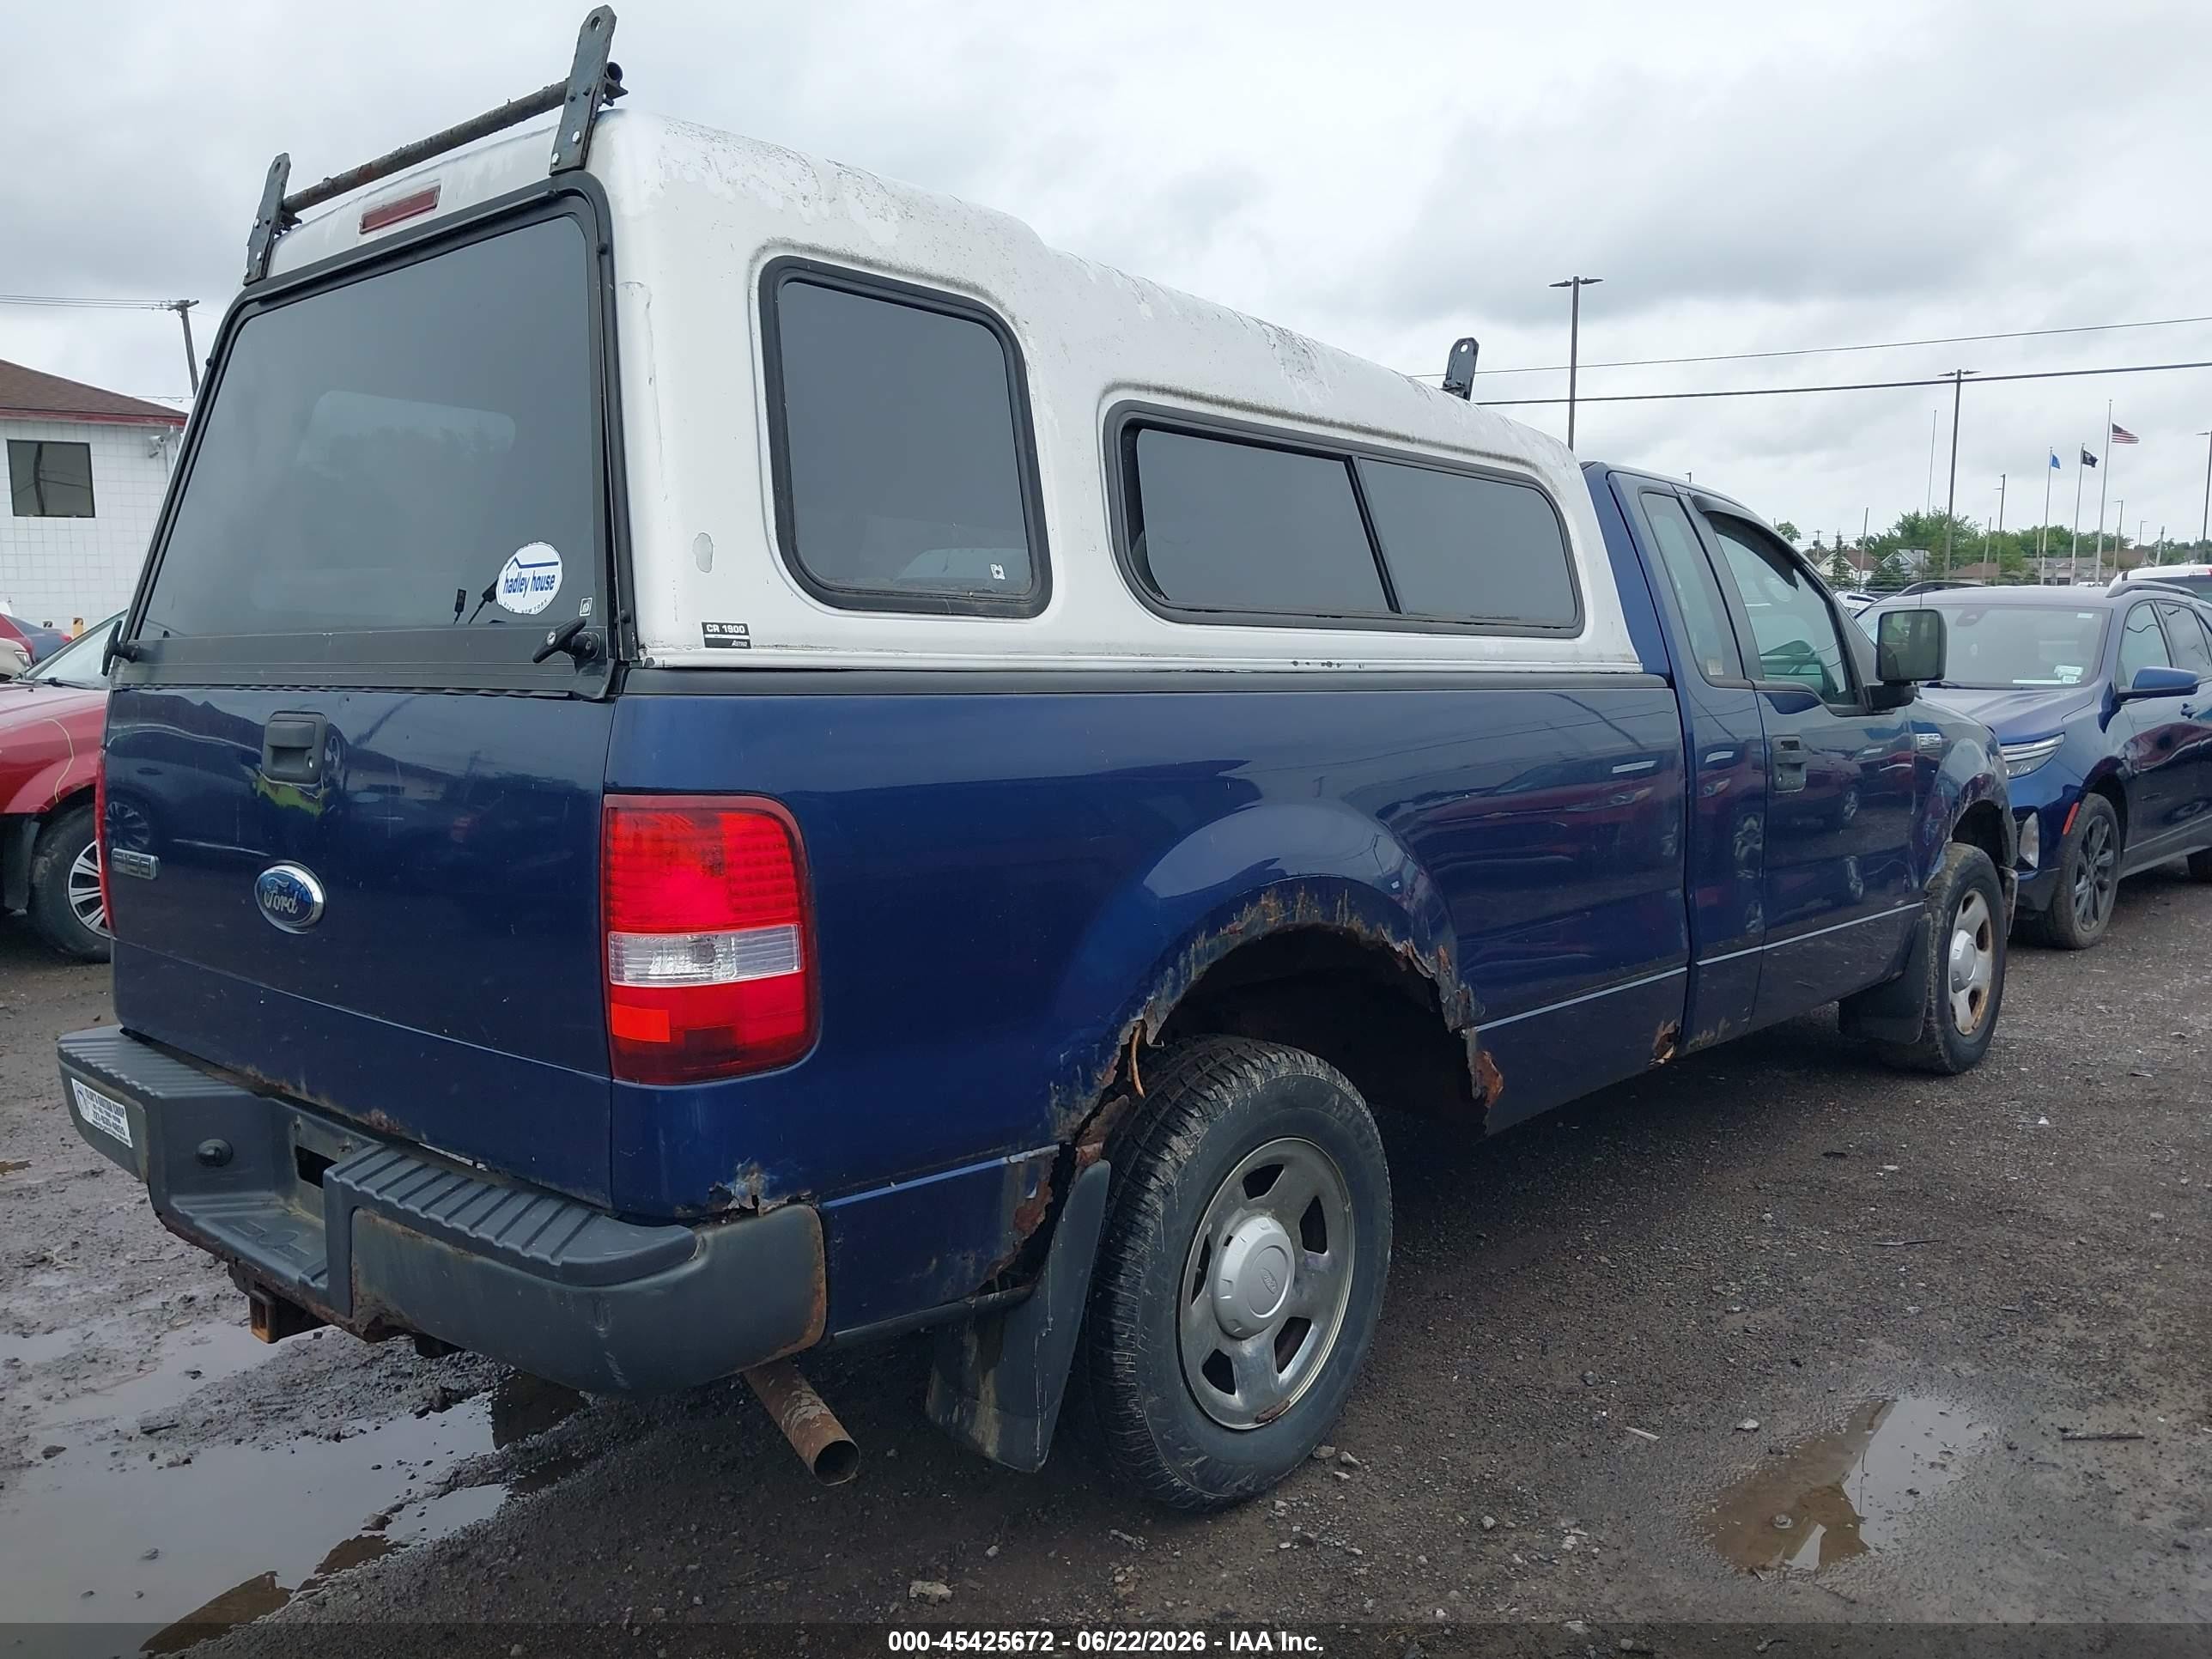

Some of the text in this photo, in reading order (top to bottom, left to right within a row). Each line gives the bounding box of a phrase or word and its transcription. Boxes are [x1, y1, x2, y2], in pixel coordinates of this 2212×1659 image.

[503, 569, 556, 599] hadley house
[264, 877, 299, 915] Ford
